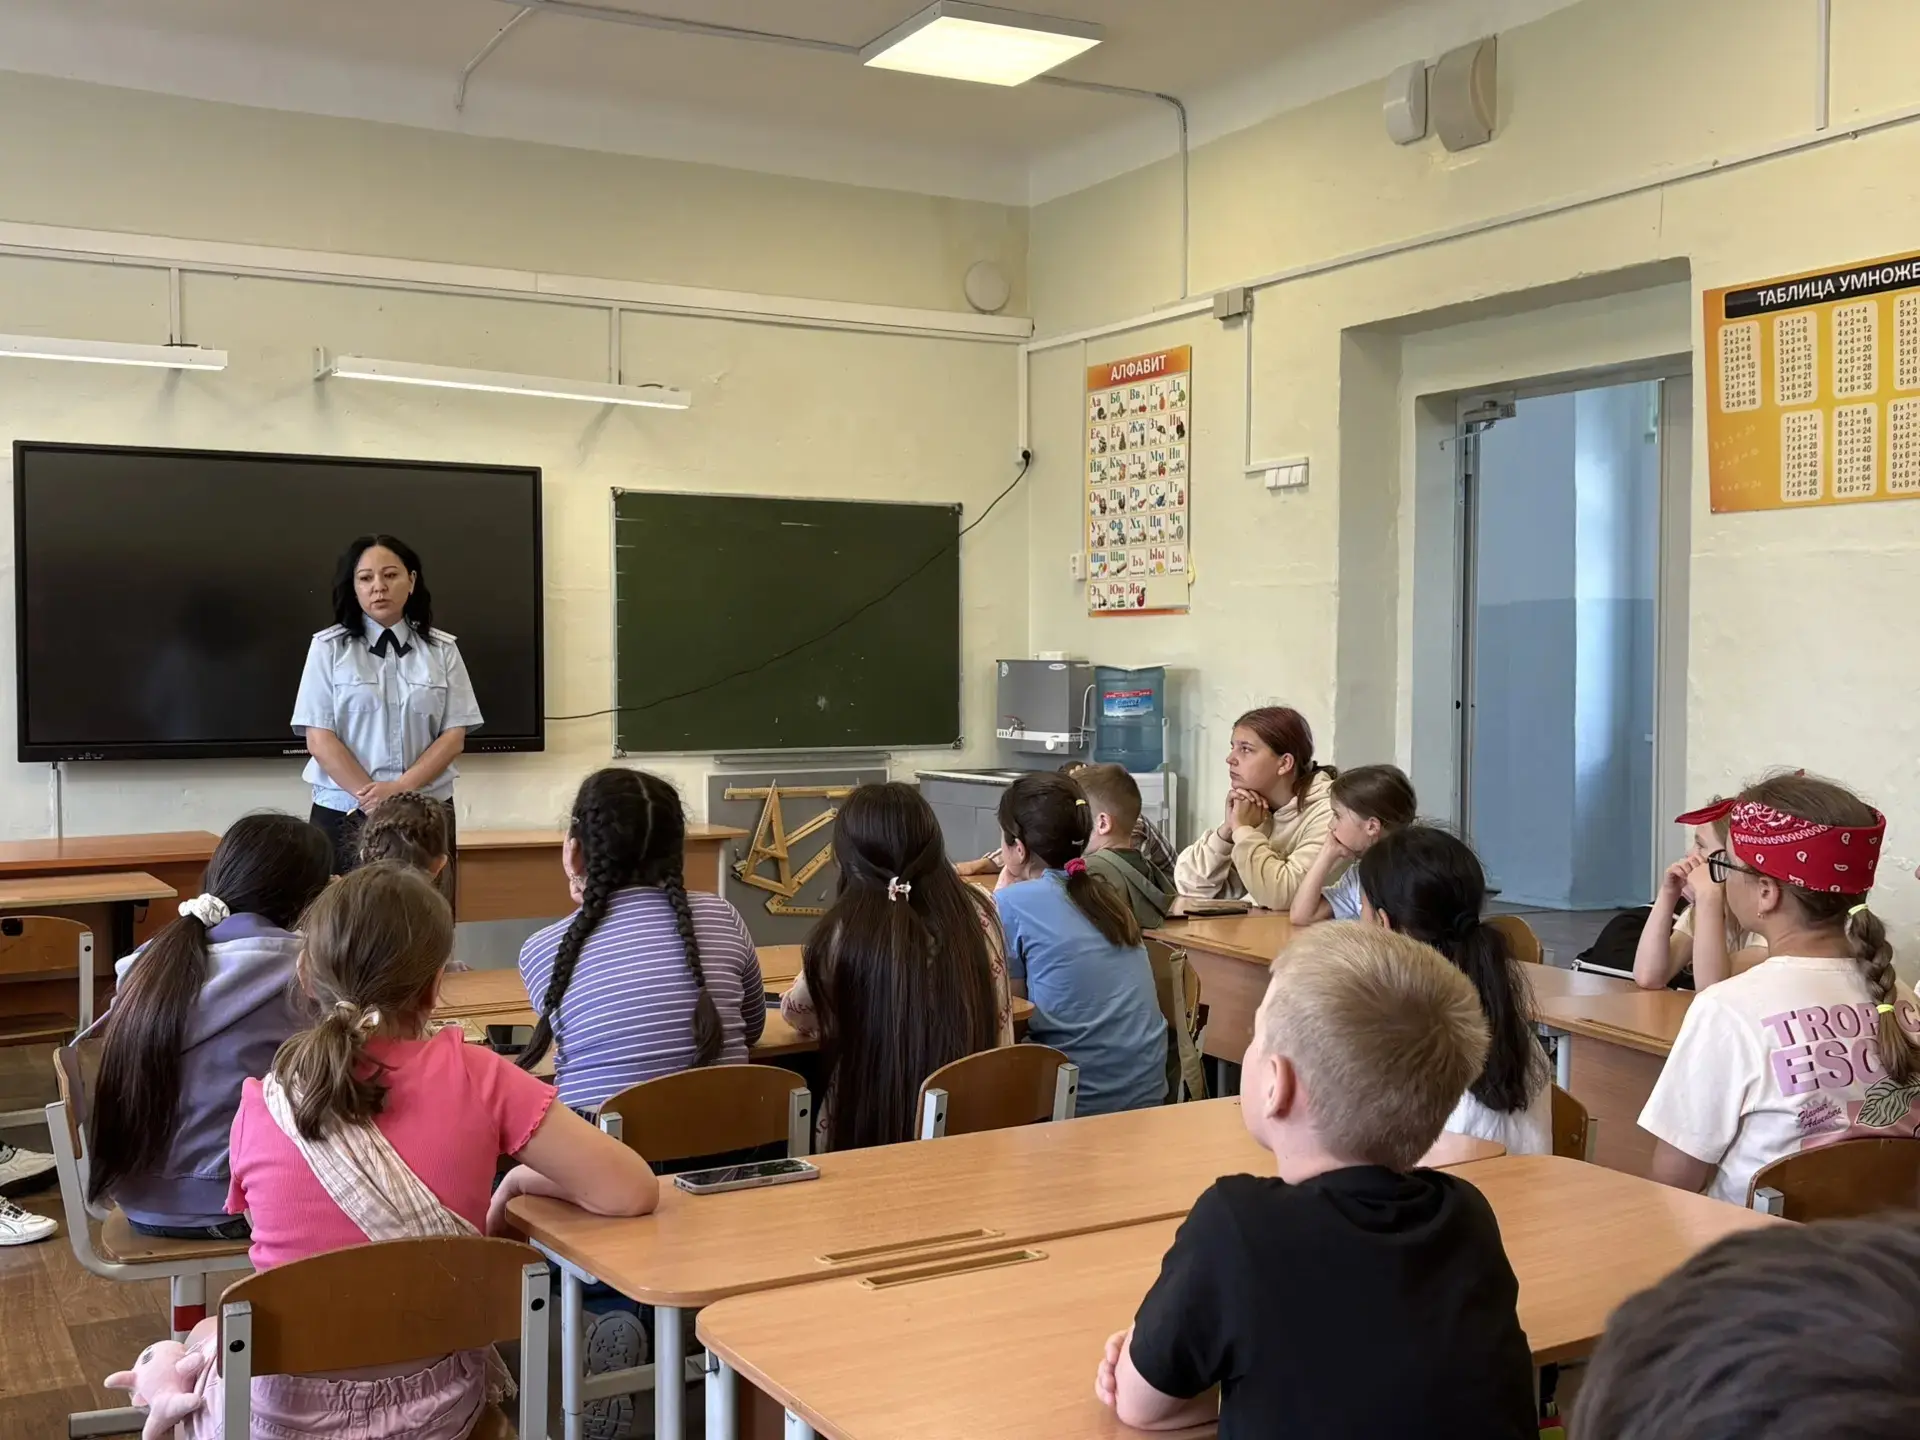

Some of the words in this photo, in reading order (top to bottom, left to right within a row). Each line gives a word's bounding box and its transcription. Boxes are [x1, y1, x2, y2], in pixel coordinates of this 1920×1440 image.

[1757, 278, 1835, 307] ТАБЛИЦА
[1111, 355, 1166, 380] АЛФАВИТ
[1762, 1000, 1920, 1048] TROPC
[1771, 1039, 1886, 1097] ESC
